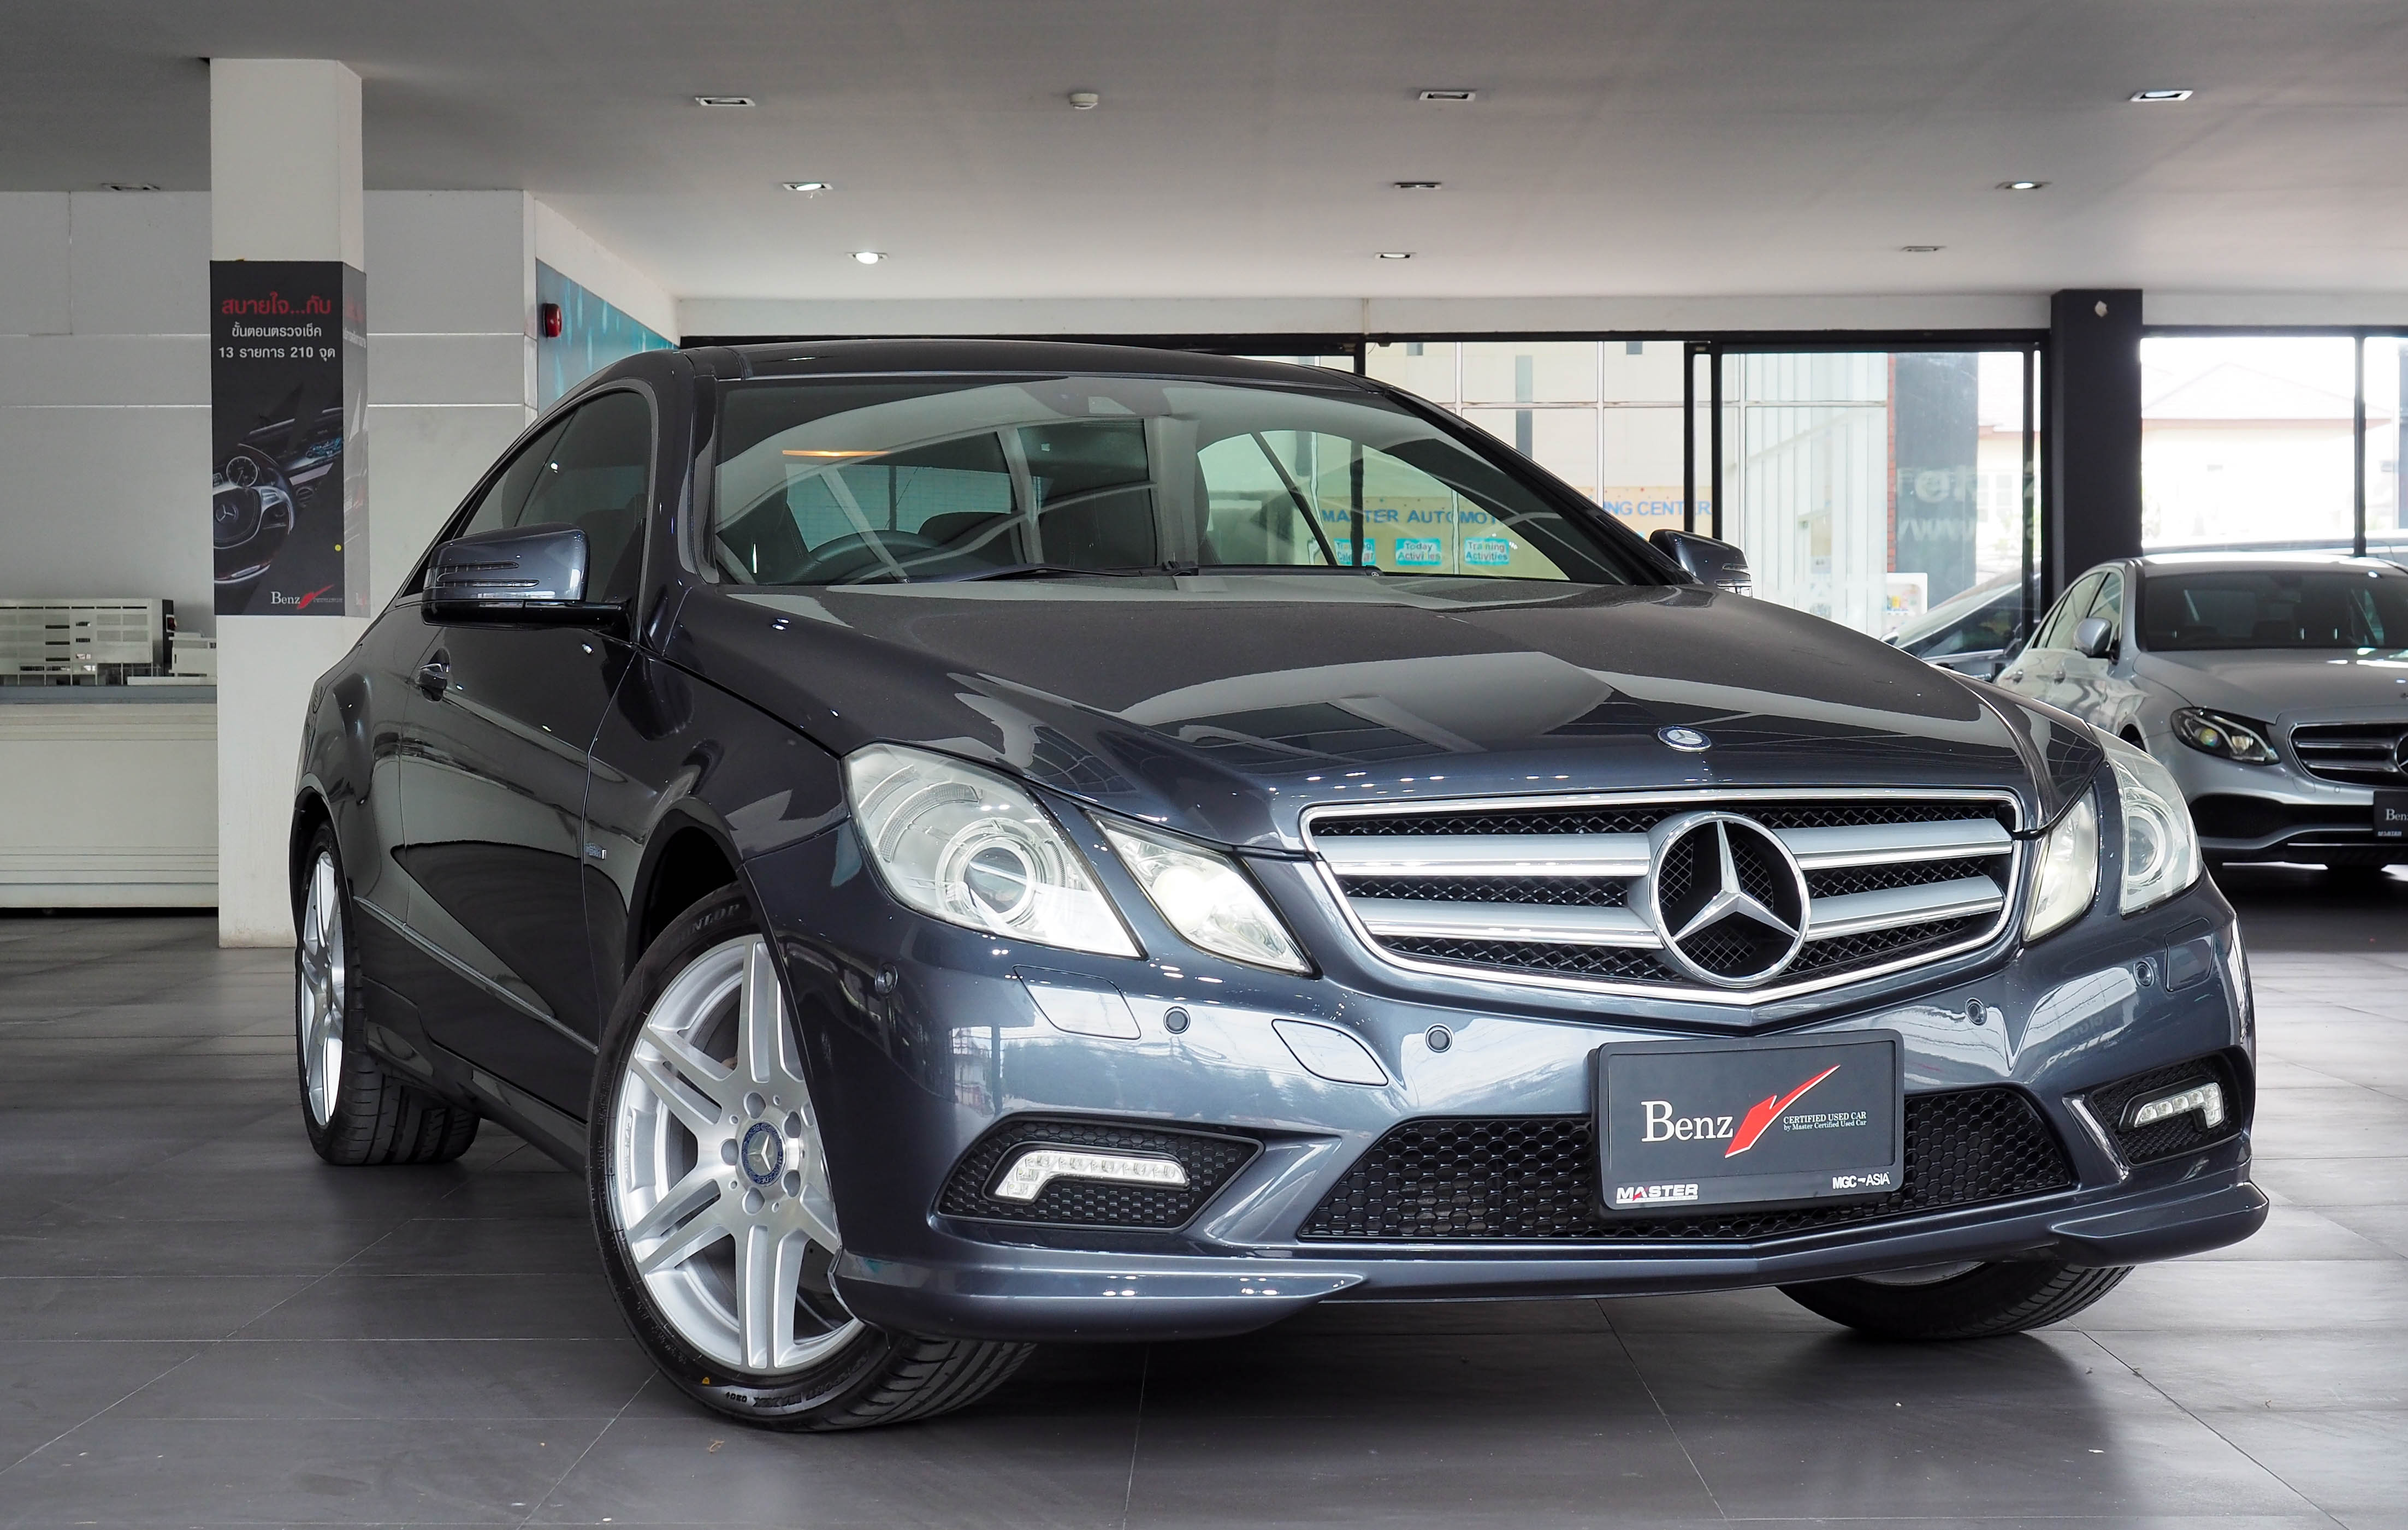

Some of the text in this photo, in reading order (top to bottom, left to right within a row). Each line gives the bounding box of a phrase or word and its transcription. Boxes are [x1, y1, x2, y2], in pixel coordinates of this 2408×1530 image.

[222, 291, 331, 314] สบายใจ...กับ
[232, 321, 322, 337] ขั้นตอนตรวจเช็ค
[218, 347, 335, 361] 13 รายการ 210 จุด
[1321, 509, 1399, 523] MATER
[1637, 500, 1713, 516] CENTR
[1405, 542, 1433, 551] Today
[1468, 541, 1505, 553] Training
[1465, 551, 1508, 560] Activities
[270, 591, 300, 604] Benz
[2386, 809, 2408, 821] Ben
[1641, 1100, 1733, 1142] Benz
[1783, 1111, 1867, 1124] CERTIFIED USED CAR
[1814, 1121, 1839, 1129] Certified
[1617, 1183, 1699, 1199] MASTER
